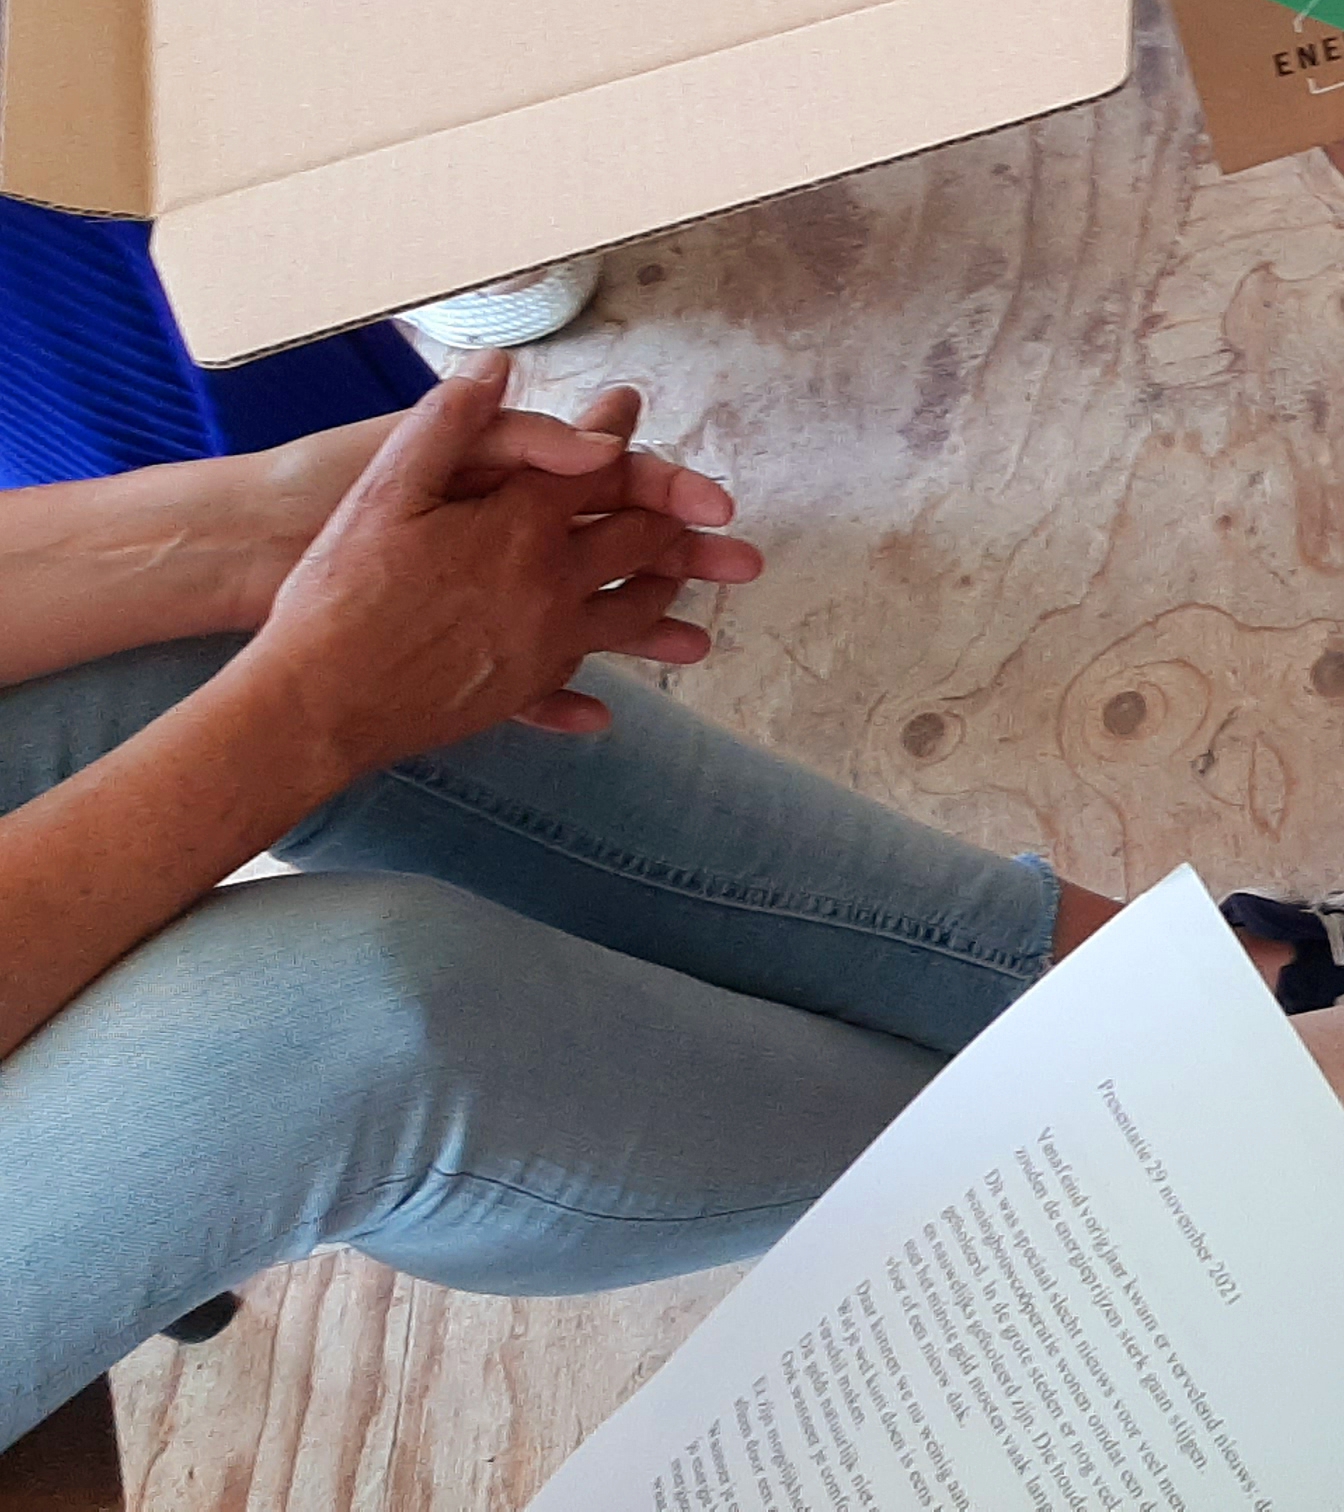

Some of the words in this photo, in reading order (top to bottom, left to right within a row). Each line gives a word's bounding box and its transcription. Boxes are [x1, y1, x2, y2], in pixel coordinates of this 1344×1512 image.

[983, 1167, 1004, 1198] Dit
[998, 1195, 1020, 1229] was
[1011, 1227, 1059, 1292] speciaal
[1048, 1291, 1083, 1340] slecht
[1074, 1339, 1116, 1398] nieuws
[1112, 1398, 1142, 1439] voor
[1135, 1440, 1169, 1477] veel
[1013, 1144, 1049, 1200] zouden
[1041, 1199, 1061, 1221] de
[1053, 1220, 1123, 1329] energieprijzen
[1115, 1327, 1149, 1372] sterk
[1137, 1371, 1174, 1413] gaan
[1168, 1413, 1208, 1475] stijgen.
[1036, 1125, 1073, 1180] Vanaf
[1059, 1166, 1090, 1208] eind
[1078, 1204, 1110, 1253] vorig
[1096, 1241, 1129, 1279] jaar
[1121, 1276, 1159, 1332] kwam
[1152, 1332, 1171, 1350] er
[1165, 1350, 1225, 1433] vervelend
[1212, 1432, 1259, 1499] nieuws:
[1095, 1077, 1152, 1163] Presentatie
[1143, 1158, 1168, 1183] 29
[1157, 1184, 1213, 1263] november
[1207, 1260, 1242, 1306] 2021
